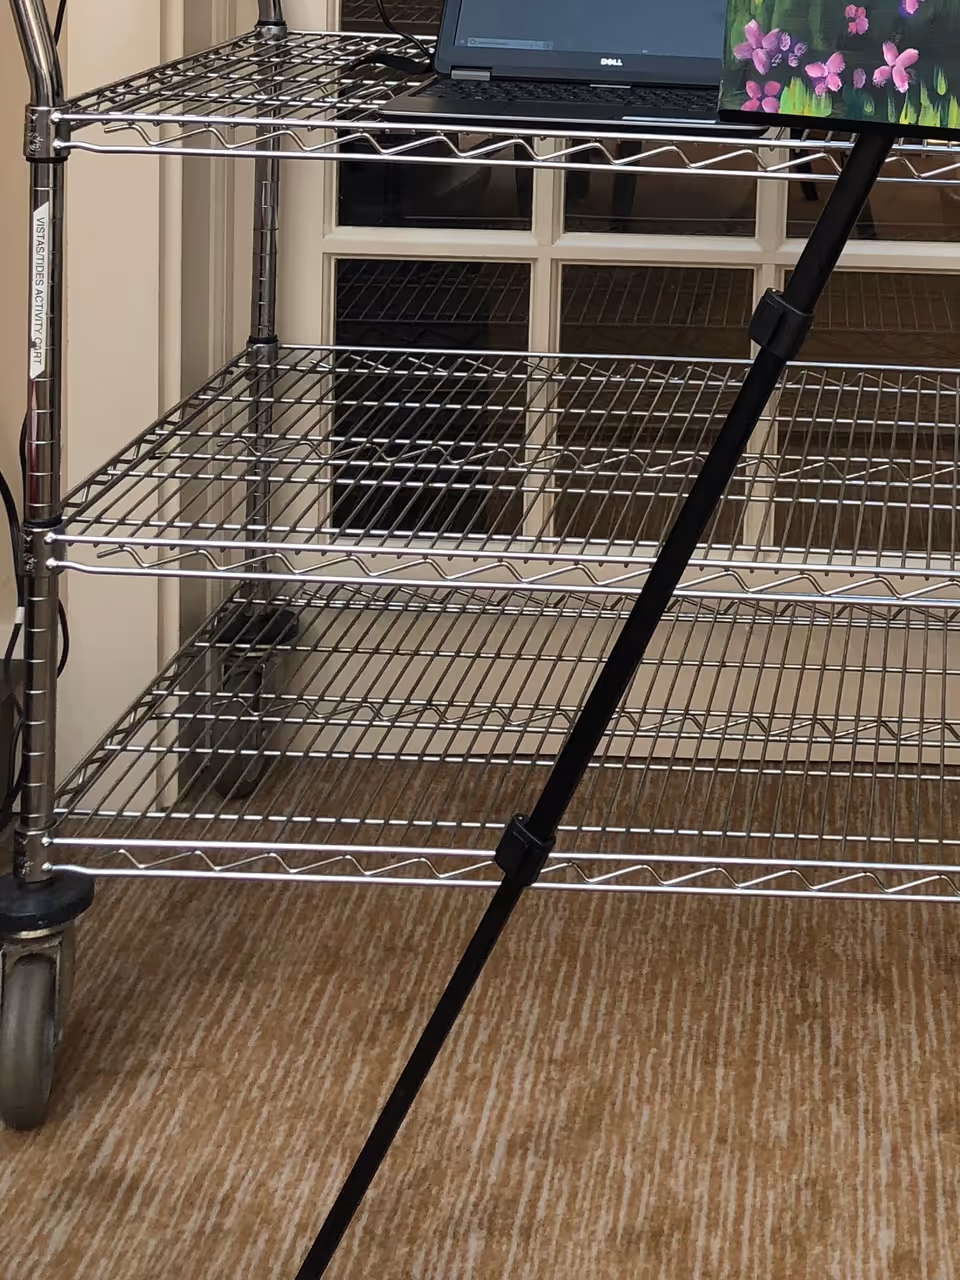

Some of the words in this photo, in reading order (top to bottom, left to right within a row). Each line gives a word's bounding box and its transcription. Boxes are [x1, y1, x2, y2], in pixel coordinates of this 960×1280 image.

[600, 58, 623, 66] DELL
[35, 216, 46, 287] VISTAS/TIDES
[34, 288, 44, 335] ACTIVITY
